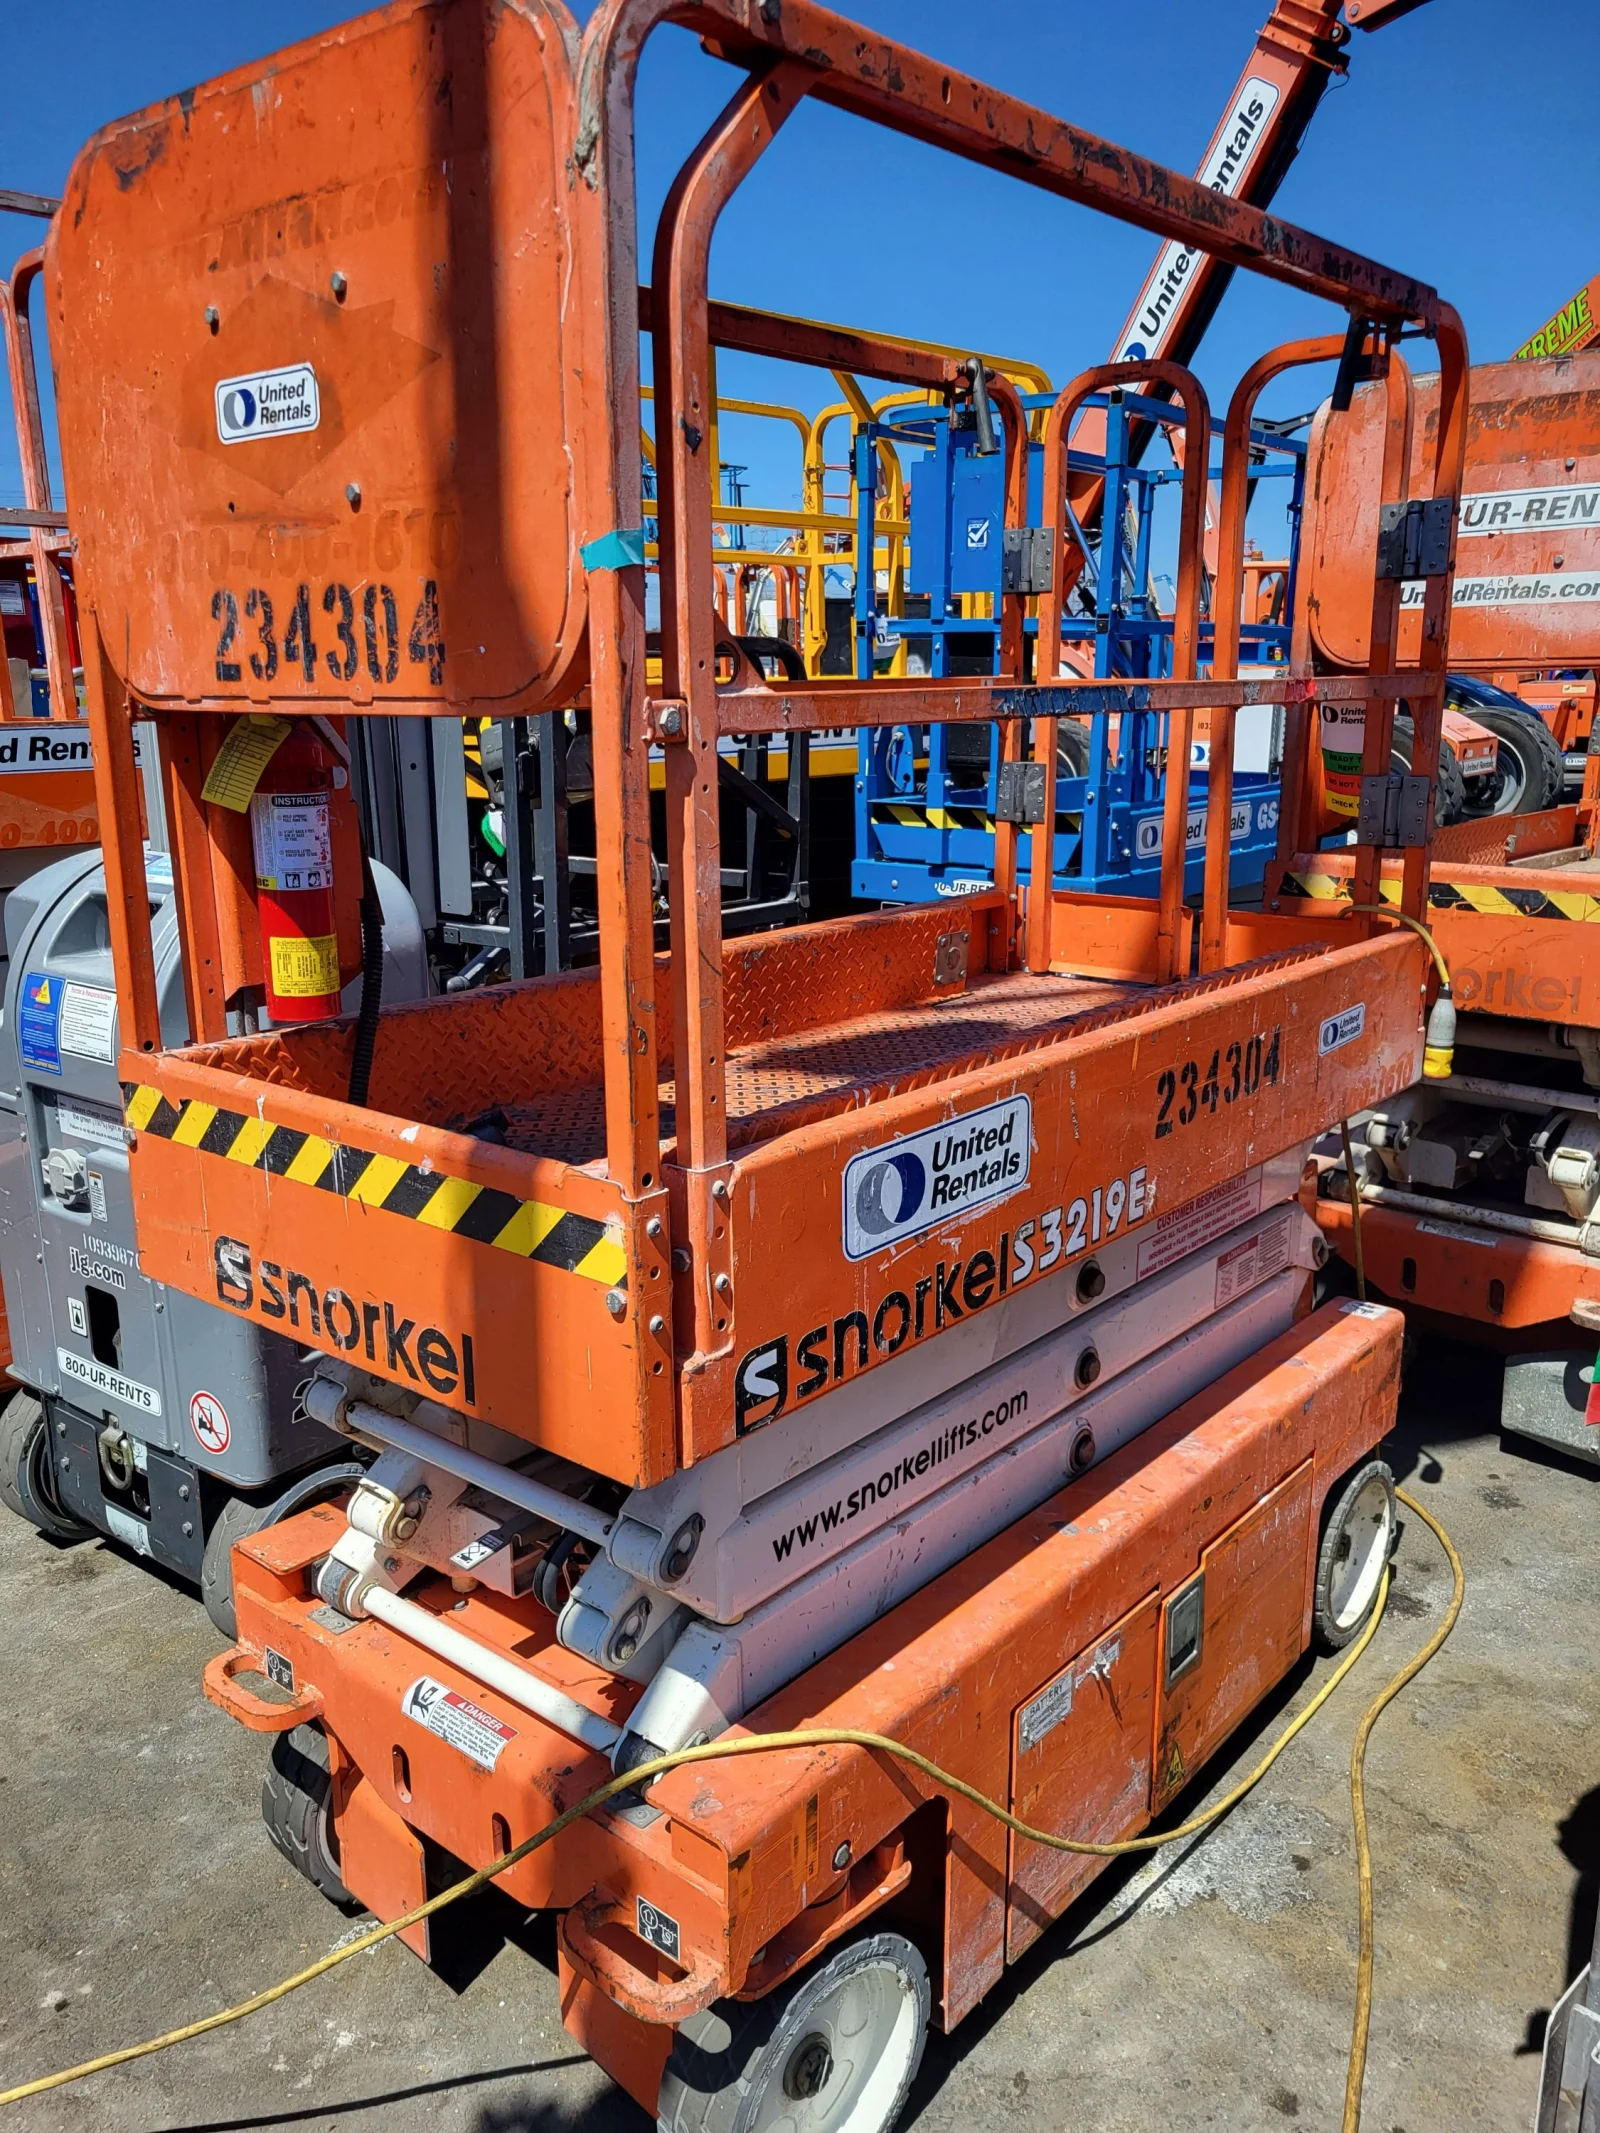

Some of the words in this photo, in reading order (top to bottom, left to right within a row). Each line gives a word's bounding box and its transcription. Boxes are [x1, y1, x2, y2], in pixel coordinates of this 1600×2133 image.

[1212, 98, 1264, 196] entals
[1514, 287, 1592, 360] TREME
[259, 378, 305, 404] United
[260, 400, 311, 425] Rentals
[211, 580, 446, 686] 234304
[1340, 707, 1366, 716] Unite
[1340, 717, 1365, 725] Rent
[28, 736, 141, 761] Rens
[1452, 967, 1582, 1014] orkel
[1339, 1023, 1361, 1039] Rentals
[1340, 1013, 1360, 1029] United
[1155, 1024, 1281, 1139] 234304
[932, 1112, 1015, 1173] United
[930, 1148, 1021, 1210] Rentals
[1157, 1201, 1195, 1230] CUSTOMER
[1195, 1174, 1248, 1212] RESPONSIBILITY
[70, 1248, 125, 1289] jlg.com
[797, 1232, 1009, 1400] snorkel
[1012, 1165, 1149, 1286] S3219E
[259, 1260, 476, 1406] snorkel
[66, 1356, 151, 1407] 800-UR-RENTS
[772, 1390, 1029, 1562] www.snorkellifts.com
[464, 1702, 504, 1732] DANGER
[1029, 1682, 1063, 1718] BATTERY
